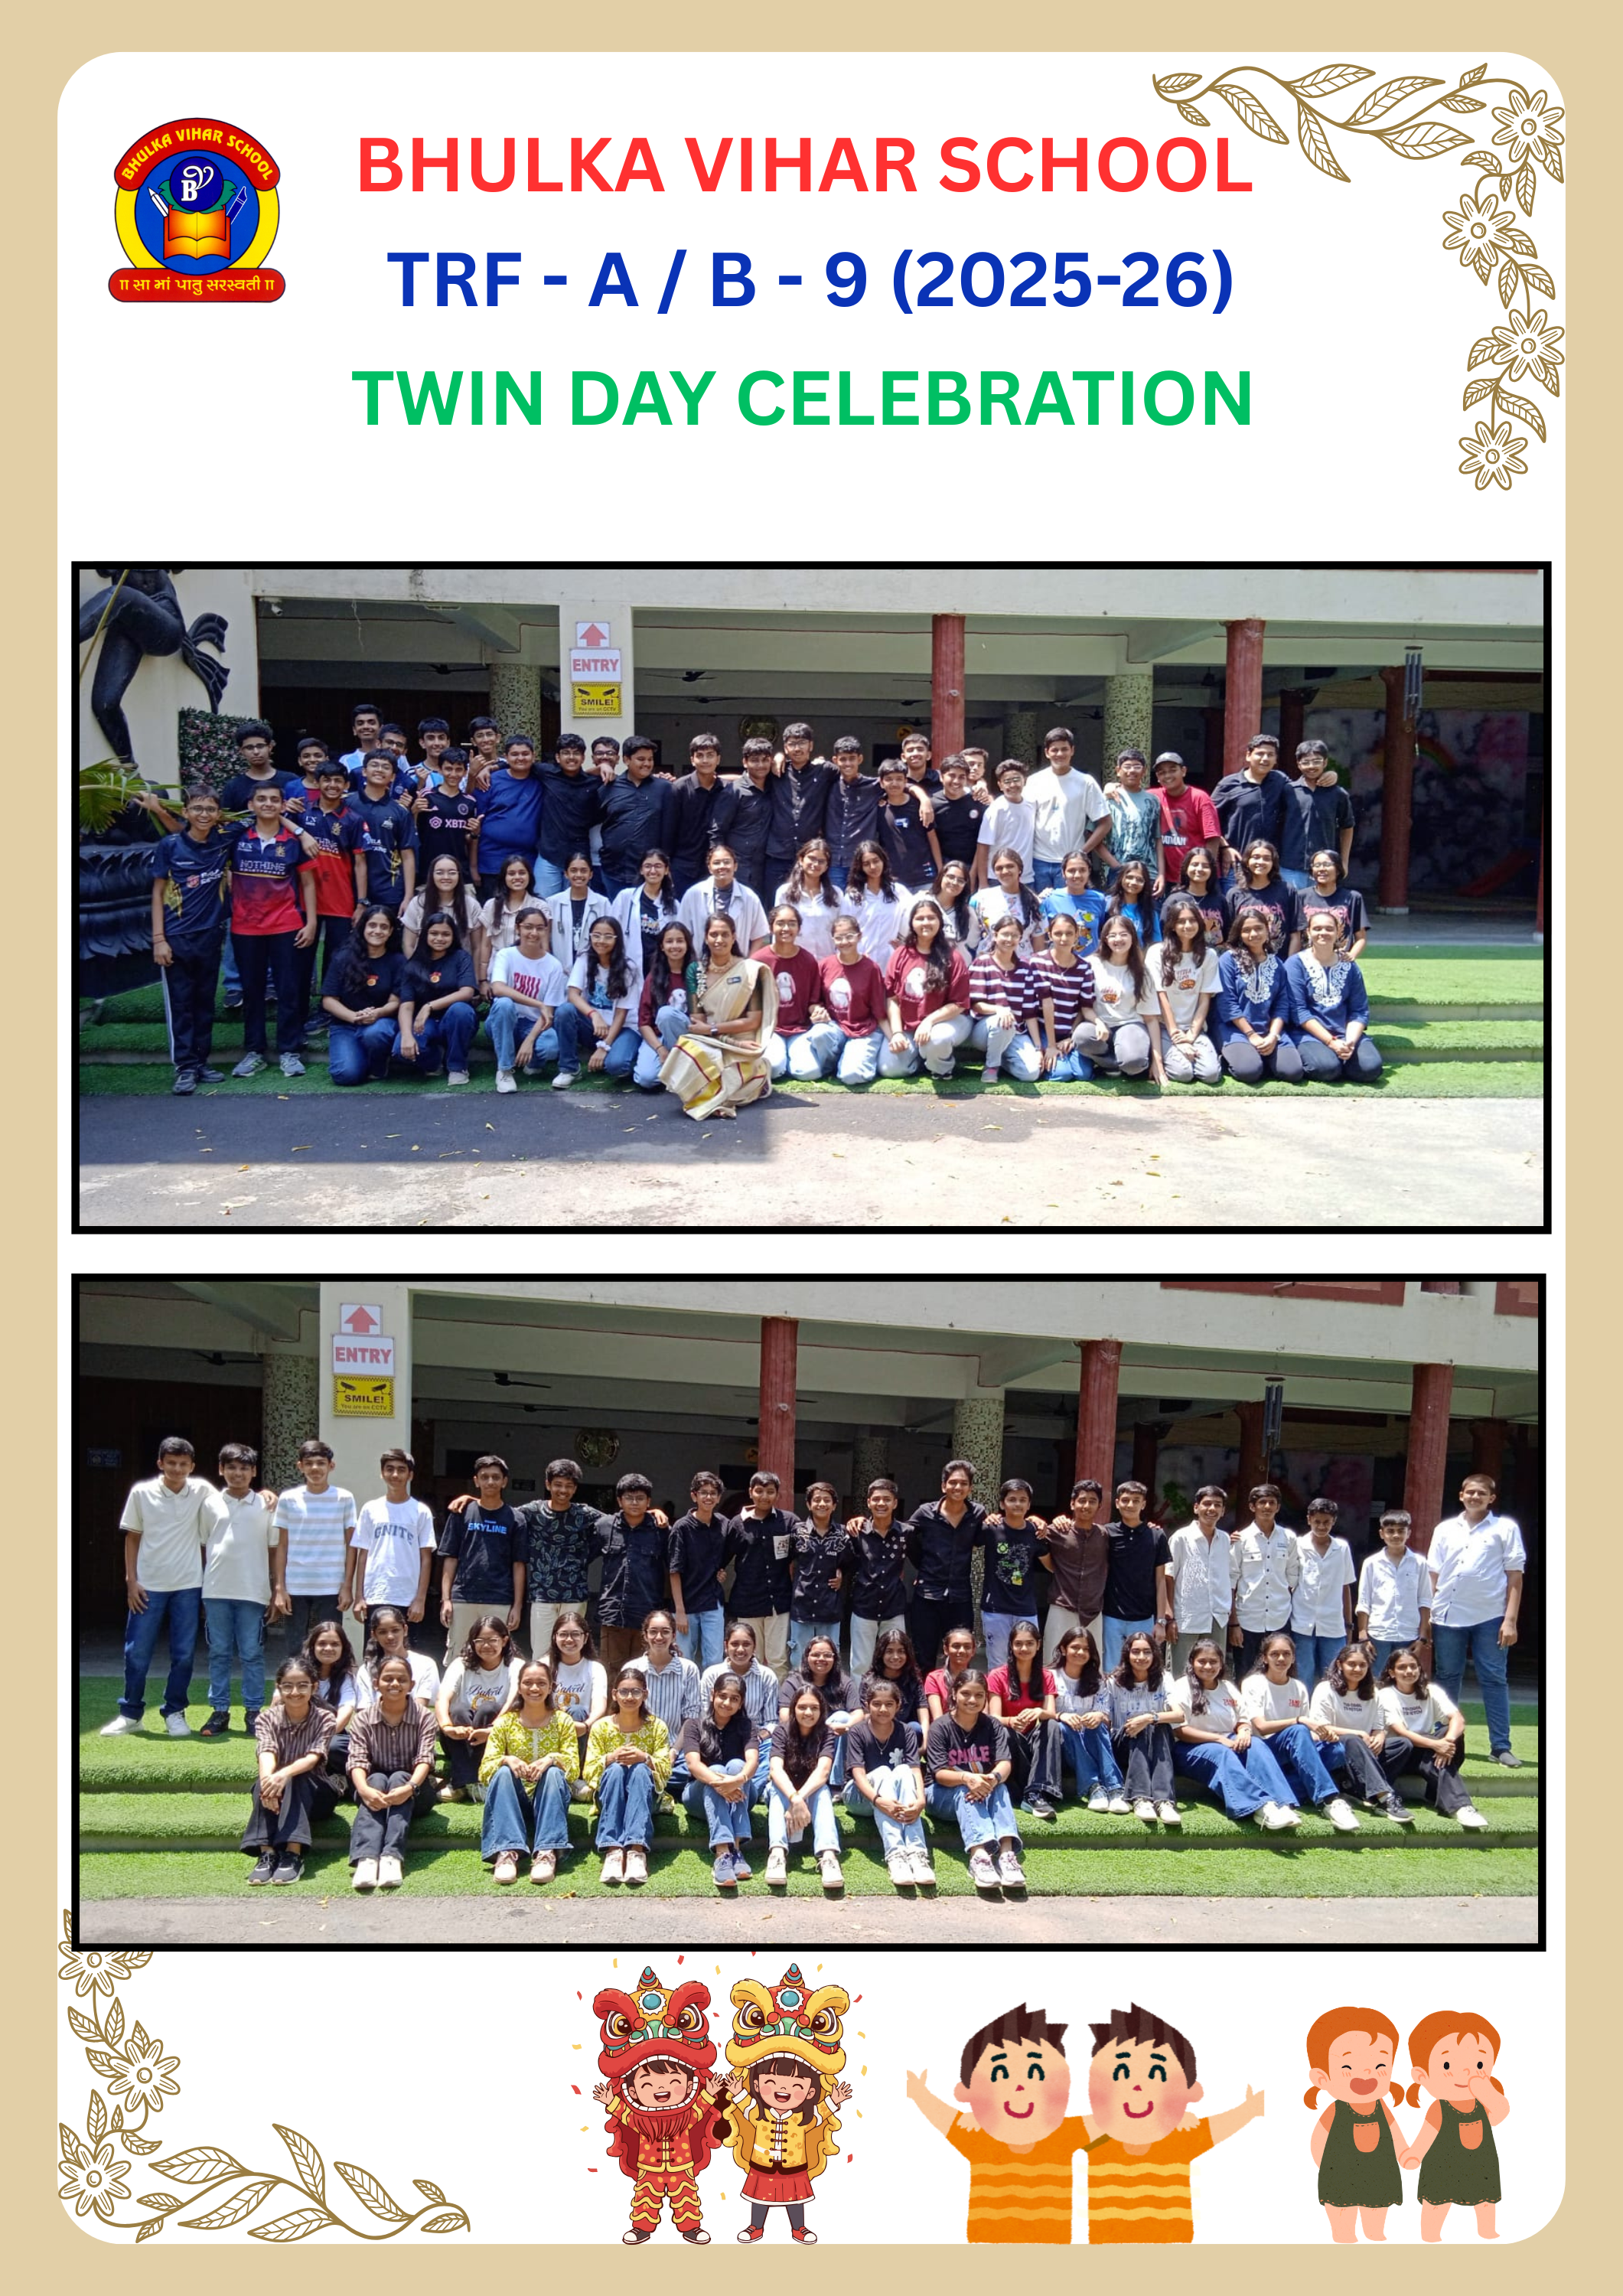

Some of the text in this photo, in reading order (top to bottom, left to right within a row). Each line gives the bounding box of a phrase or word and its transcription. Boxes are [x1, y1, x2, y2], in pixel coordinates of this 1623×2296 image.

[572, 658, 619, 672] ENTRY
[240, 859, 286, 872] NOTHING
[335, 1346, 392, 1365] ENTRY
[344, 1394, 384, 1404] SMILE!
[468, 1522, 507, 1534] SKYLINE
[948, 1745, 990, 1766] SMILE
